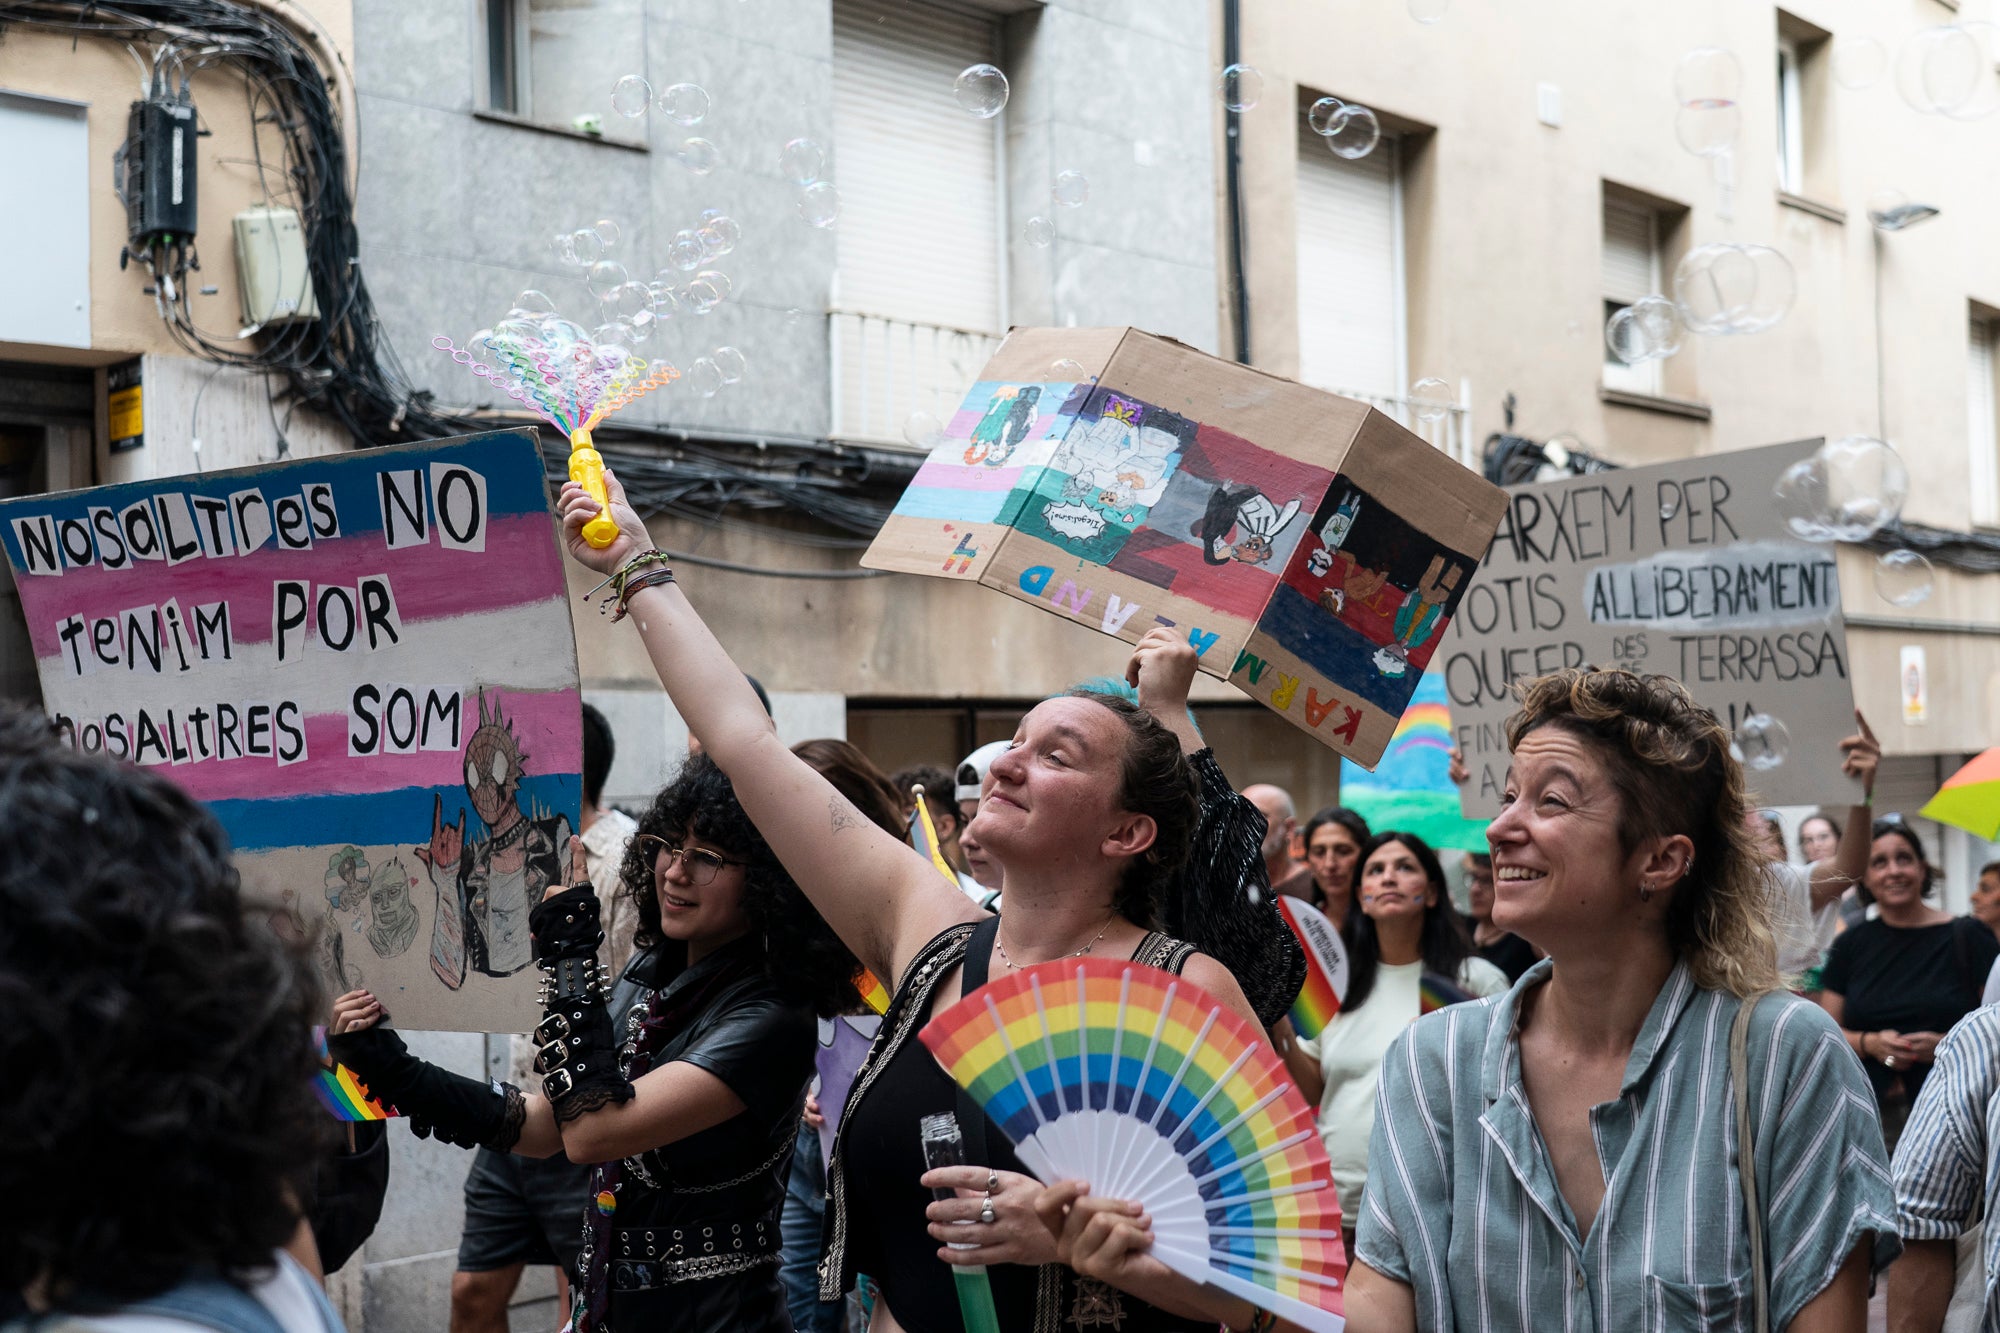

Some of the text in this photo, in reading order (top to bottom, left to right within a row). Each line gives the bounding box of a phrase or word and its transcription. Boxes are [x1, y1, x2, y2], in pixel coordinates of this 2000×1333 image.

[381, 467, 480, 545] NO
[1483, 476, 1739, 567] ARXEM PER
[277, 579, 399, 661] POR
[1613, 632, 1648, 660] DES
[1670, 630, 1845, 683] TERRASSA
[352, 683, 460, 754] SOM
